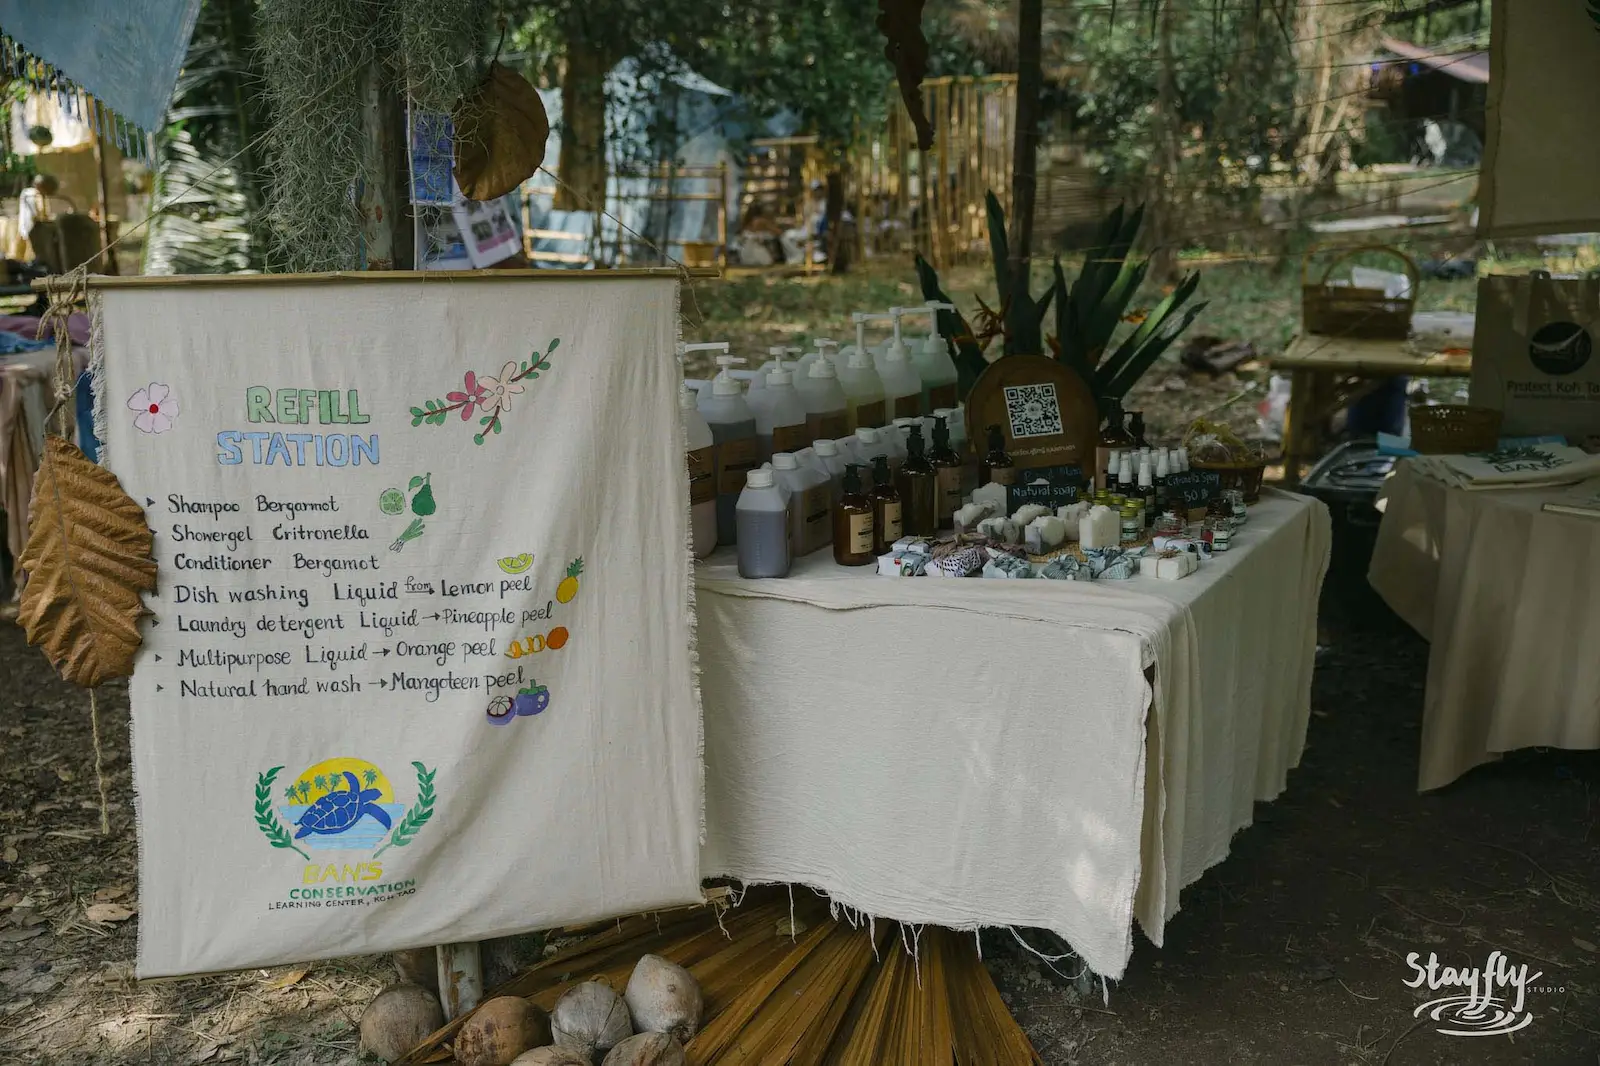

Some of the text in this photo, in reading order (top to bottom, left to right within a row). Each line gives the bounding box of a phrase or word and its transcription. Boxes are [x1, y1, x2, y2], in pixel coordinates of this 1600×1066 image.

[1556, 380, 1581, 392] Koh
[246, 385, 371, 425] REFILL
[216, 430, 380, 467] STATION
[1012, 485, 1077, 497] Natural soap
[1183, 489, 1199, 502] 50
[168, 493, 240, 521] Shampoo
[171, 524, 253, 552] Showergel
[174, 552, 380, 577] Conditioner Bergamot
[174, 575, 533, 608] Dish washing Liquid from Lemon peel
[178, 600, 553, 639] Laundry detergent Liquid Pineapple peel
[177, 638, 497, 674] Multipurpose Liquid Orange peel
[180, 665, 526, 703] Natural hand wash Mangoteen peel
[302, 860, 383, 885] BAN'S
[268, 900, 322, 911] LEARNING
[374, 895, 395, 903] KOH
[396, 888, 416, 898] TAO
[289, 878, 416, 900] CONSERVATION
